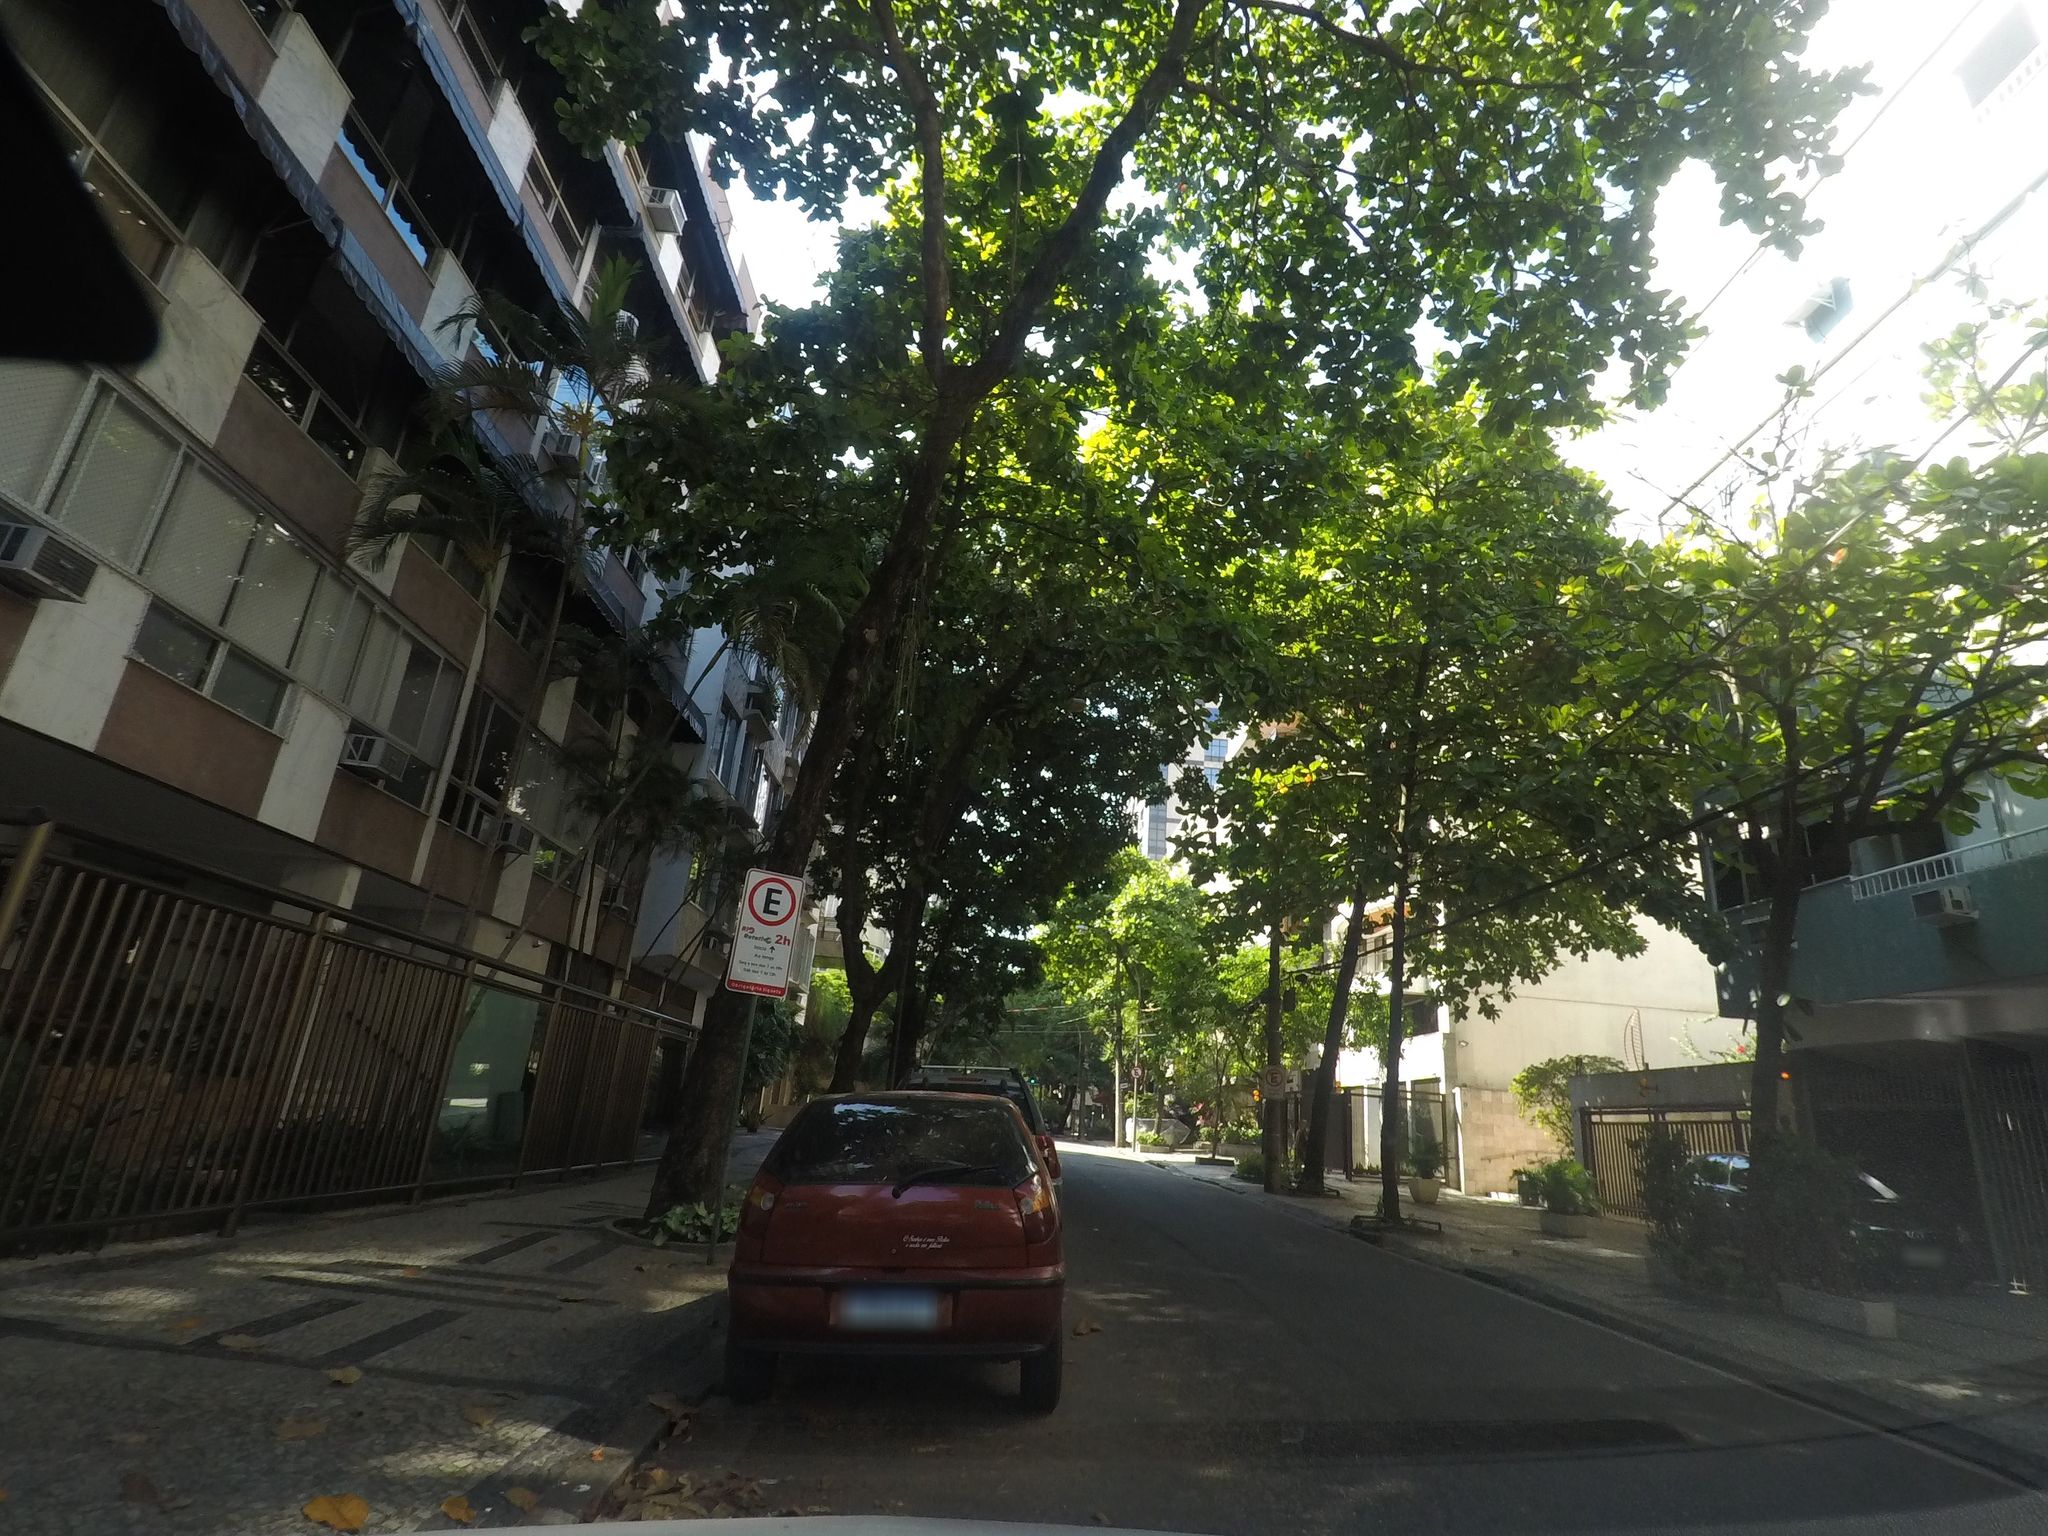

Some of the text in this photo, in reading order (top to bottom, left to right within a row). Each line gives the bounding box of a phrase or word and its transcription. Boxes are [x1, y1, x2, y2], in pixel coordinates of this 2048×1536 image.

[763, 888, 782, 916] E
[775, 935, 790, 946] 2h
[1271, 1072, 1280, 1083] E
